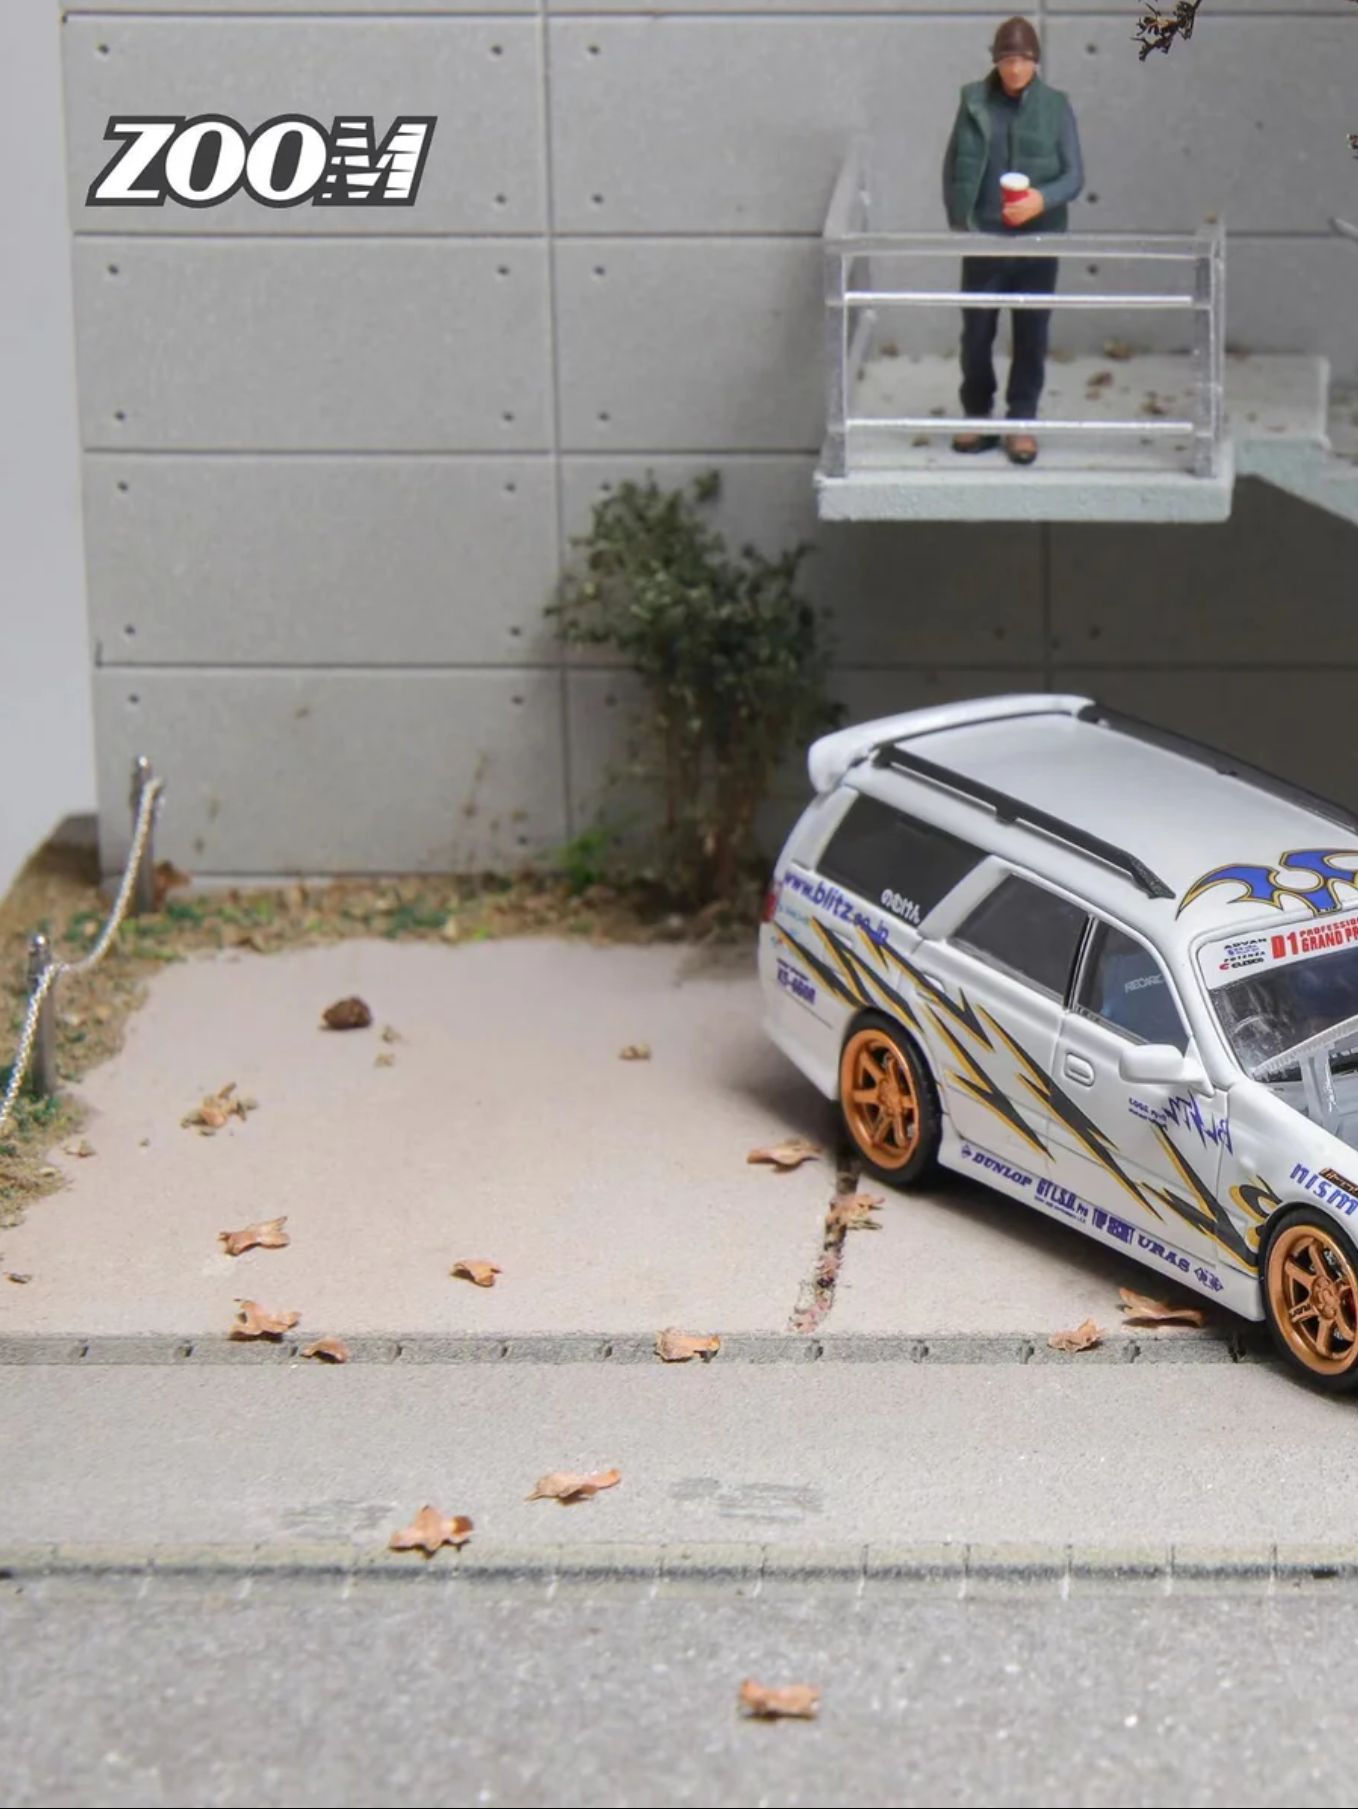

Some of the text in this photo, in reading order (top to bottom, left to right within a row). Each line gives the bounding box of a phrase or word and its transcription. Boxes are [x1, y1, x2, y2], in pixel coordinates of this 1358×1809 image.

[1271, 931, 1299, 960] D1
[1301, 928, 1344, 953] GRAND
[972, 1152, 1033, 1186] DUNLOP
[1138, 1234, 1191, 1273] URAS
